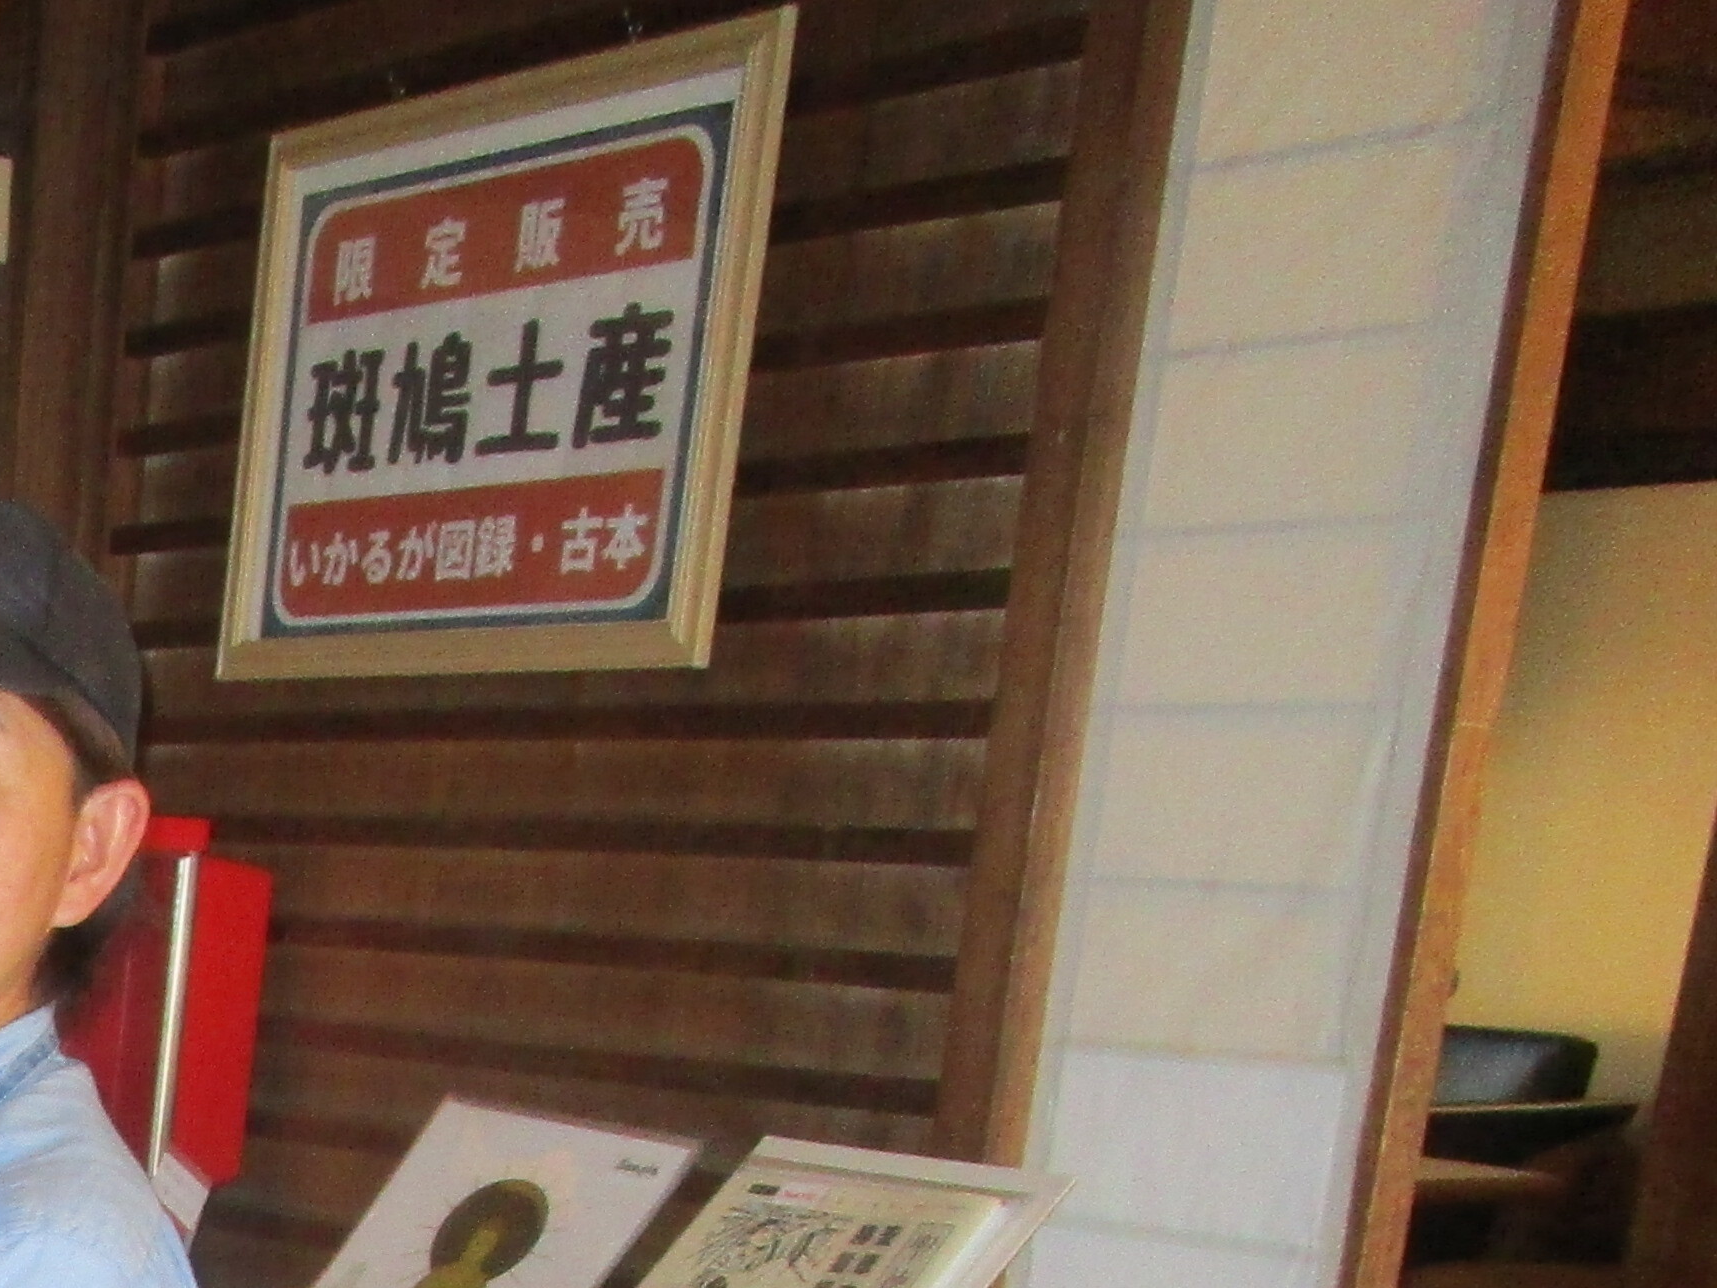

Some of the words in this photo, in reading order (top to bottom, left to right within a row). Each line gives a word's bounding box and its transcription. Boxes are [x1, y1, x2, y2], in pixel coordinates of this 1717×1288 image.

[333, 177, 668, 307] 限定販売
[303, 301, 675, 475] 斑鳩土産
[288, 502, 650, 588] いかるが図録・古本
